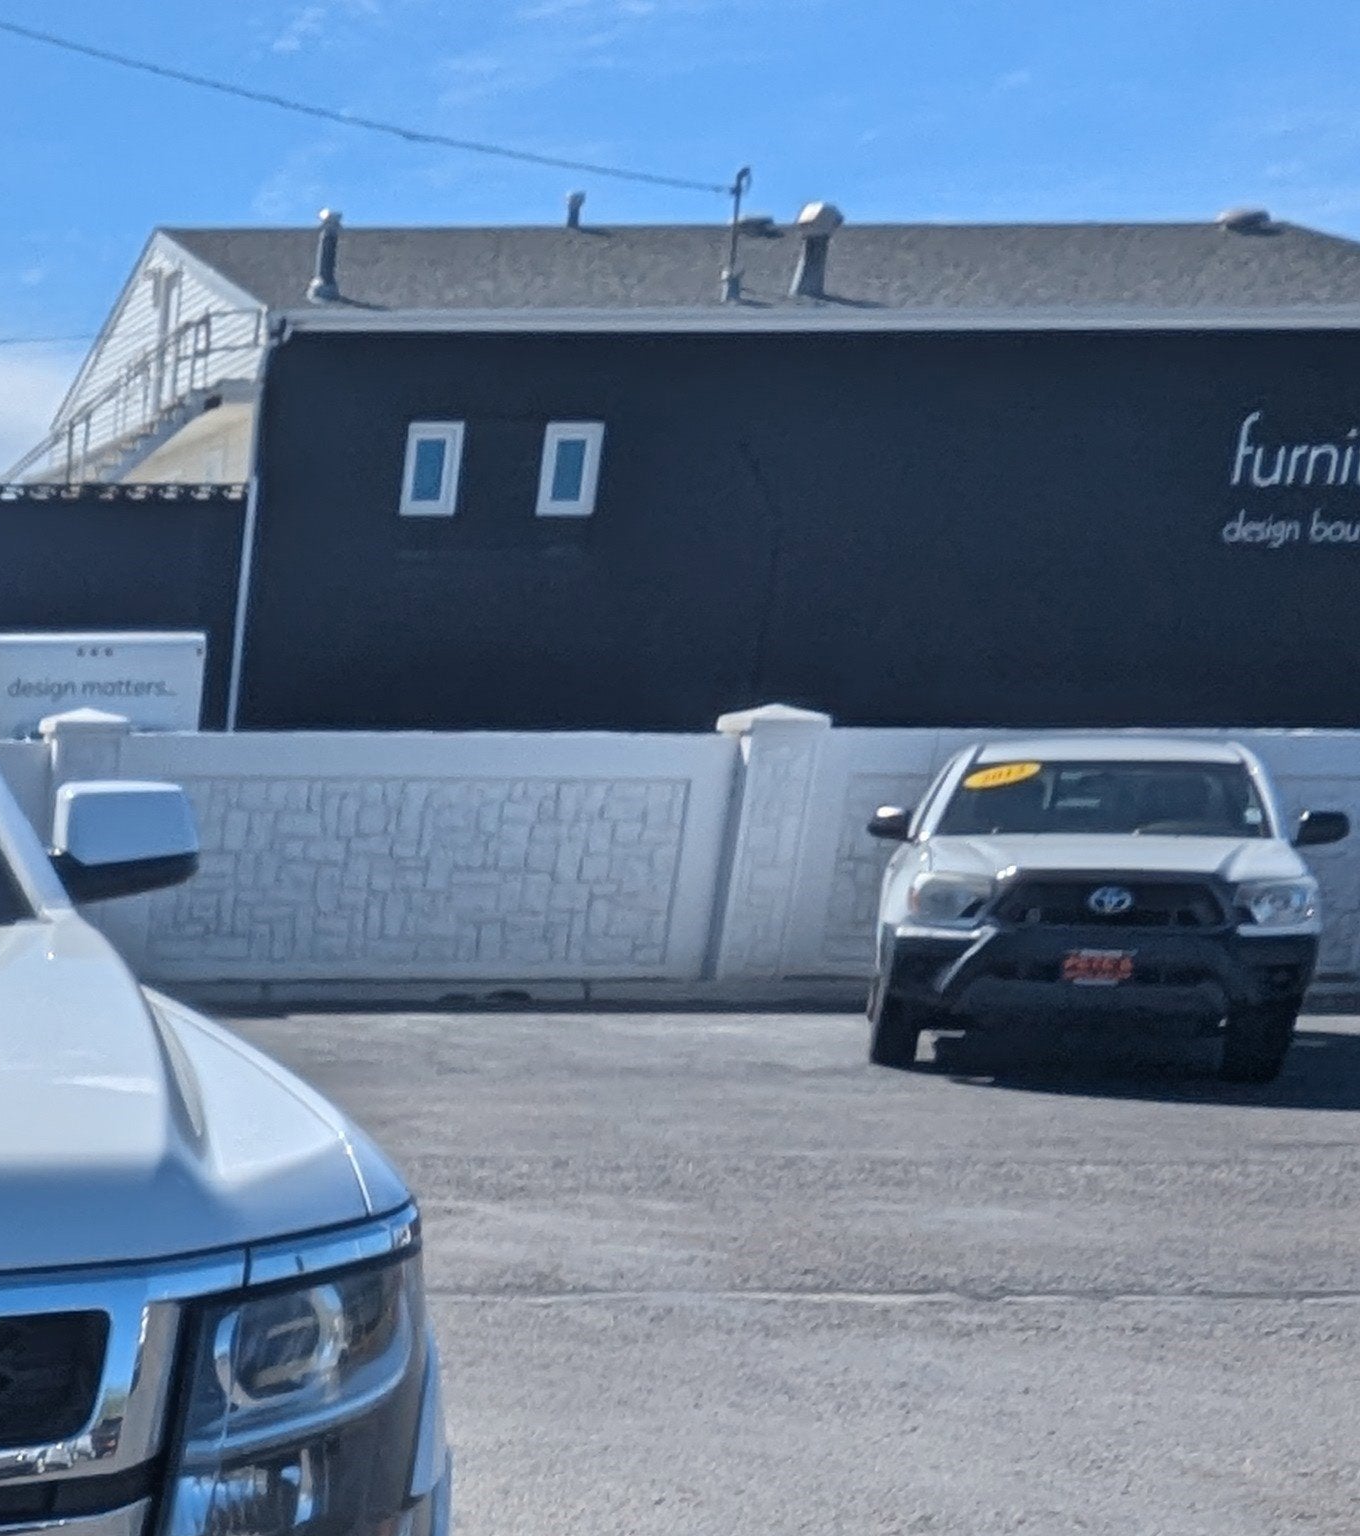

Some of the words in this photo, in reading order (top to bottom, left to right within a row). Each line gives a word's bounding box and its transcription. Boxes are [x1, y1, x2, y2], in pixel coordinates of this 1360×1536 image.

[1231, 411, 1360, 487] furni
[1222, 508, 1301, 549] design
[7, 676, 76, 703] design
